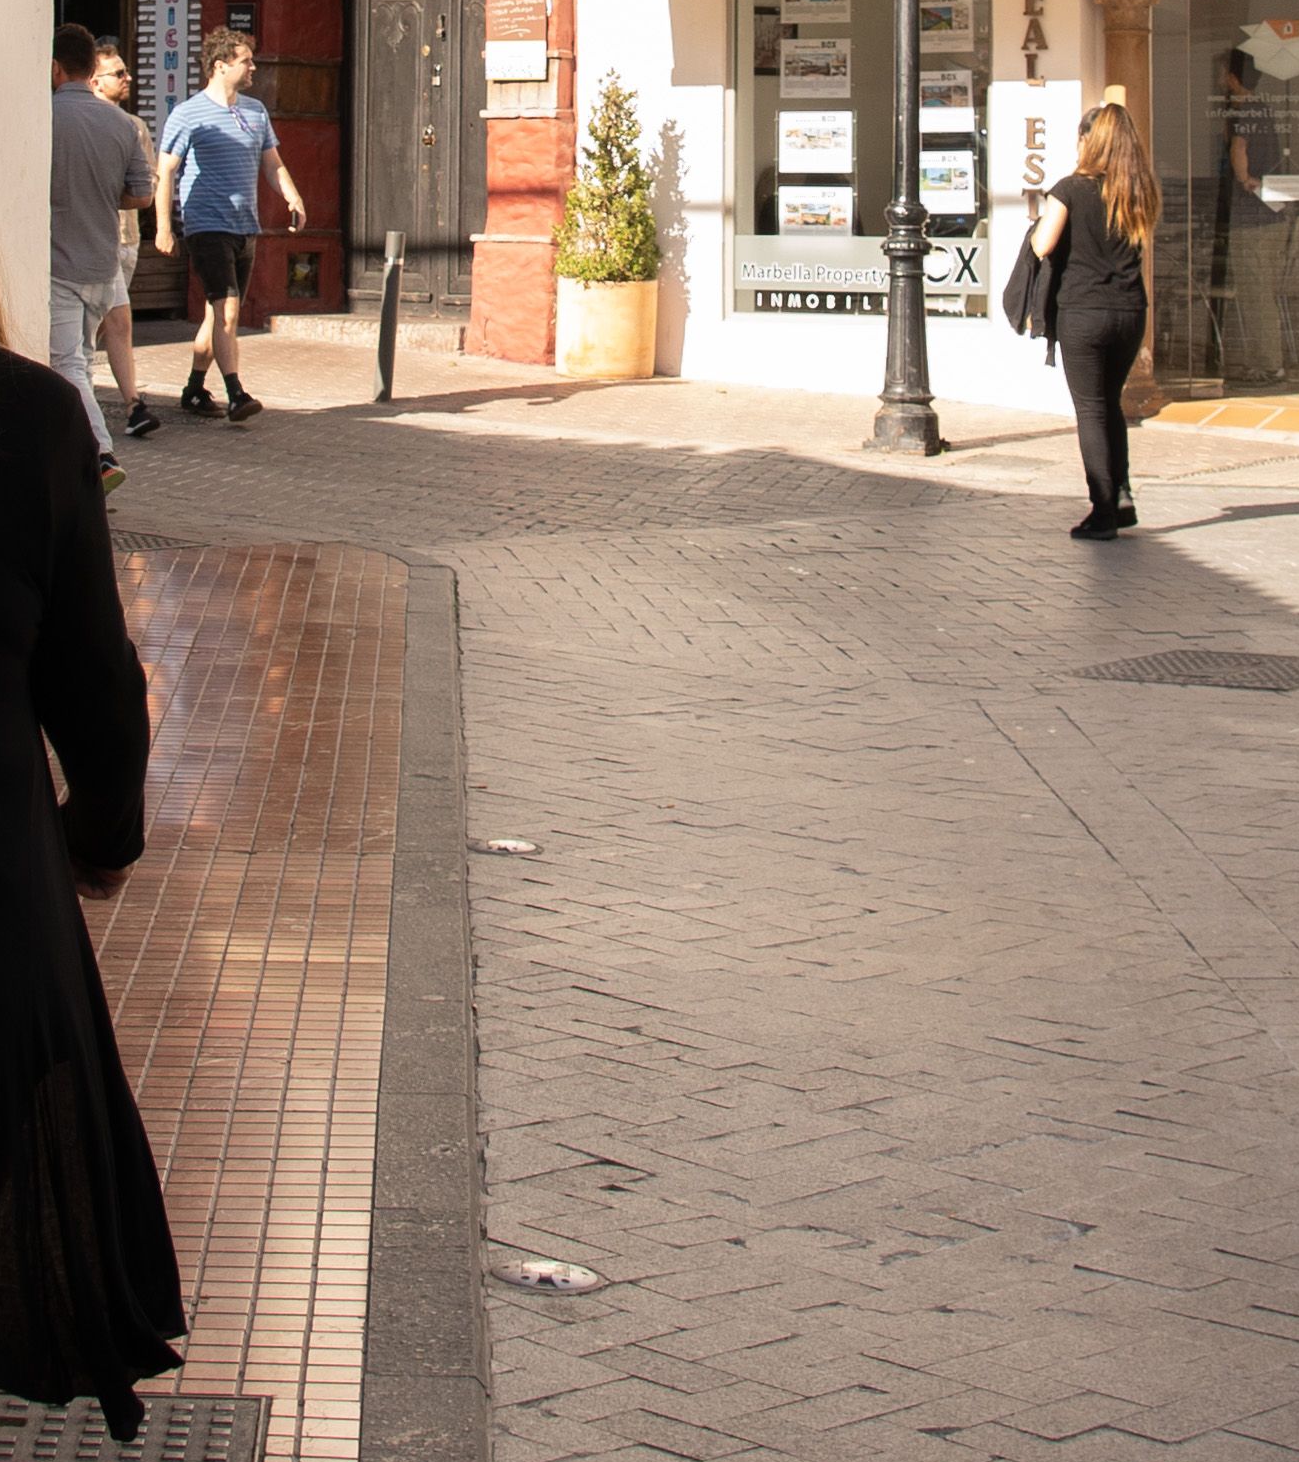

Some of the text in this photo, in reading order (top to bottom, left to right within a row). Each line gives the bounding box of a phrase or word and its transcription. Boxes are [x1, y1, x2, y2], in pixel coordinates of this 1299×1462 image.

[1021, 116, 1047, 222] EST
[742, 245, 980, 286] Marbella Property OX
[756, 291, 888, 311] INMOBILI
